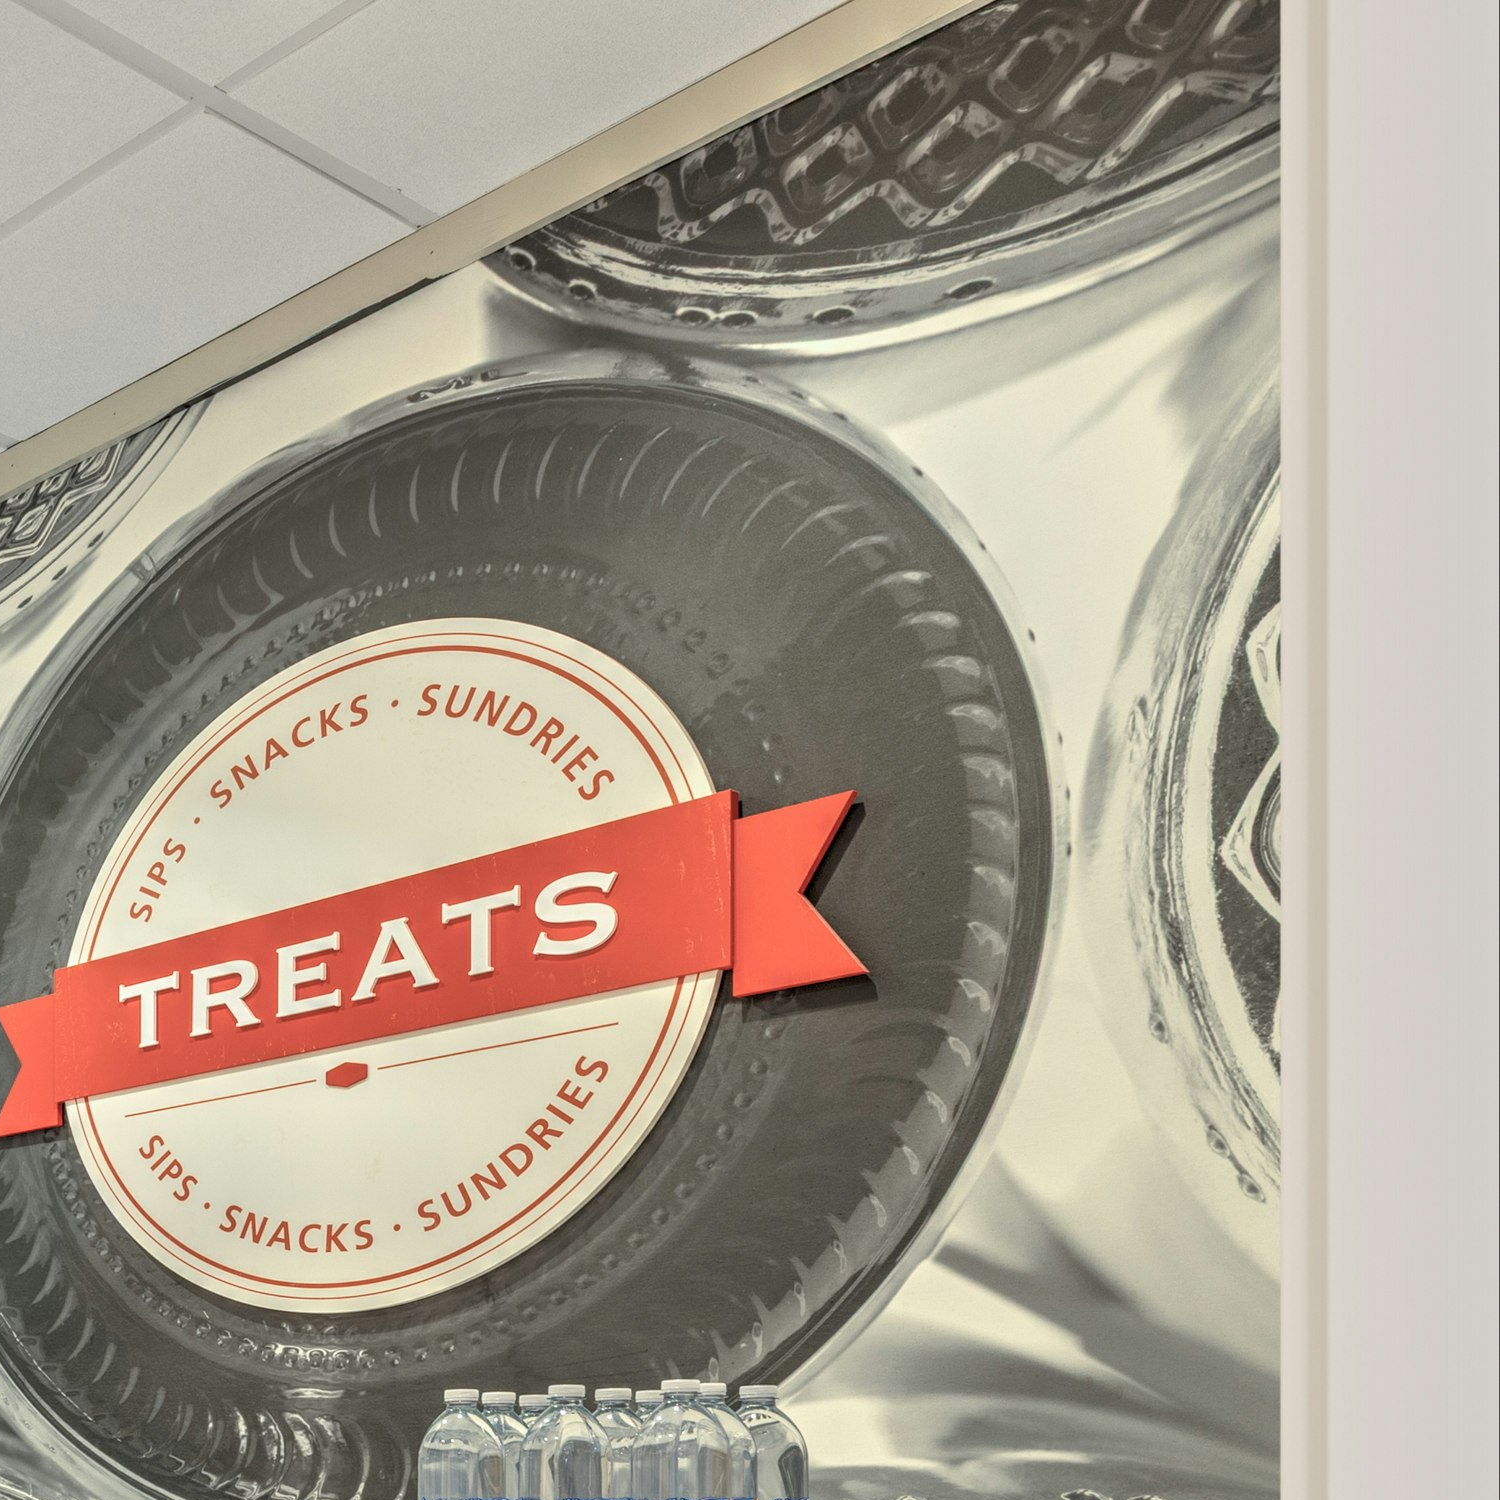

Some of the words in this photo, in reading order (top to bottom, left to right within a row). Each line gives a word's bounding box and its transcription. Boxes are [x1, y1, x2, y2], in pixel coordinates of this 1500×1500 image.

[129, 835, 188, 924] SIPS
[210, 693, 371, 808] SNACKS
[418, 684, 615, 802] SUNDRIES
[119, 870, 619, 1048] TREATS
[138, 1134, 197, 1201] SIPS
[219, 1204, 374, 1254] SNACKS
[417, 1054, 610, 1232] SUNDRIES
